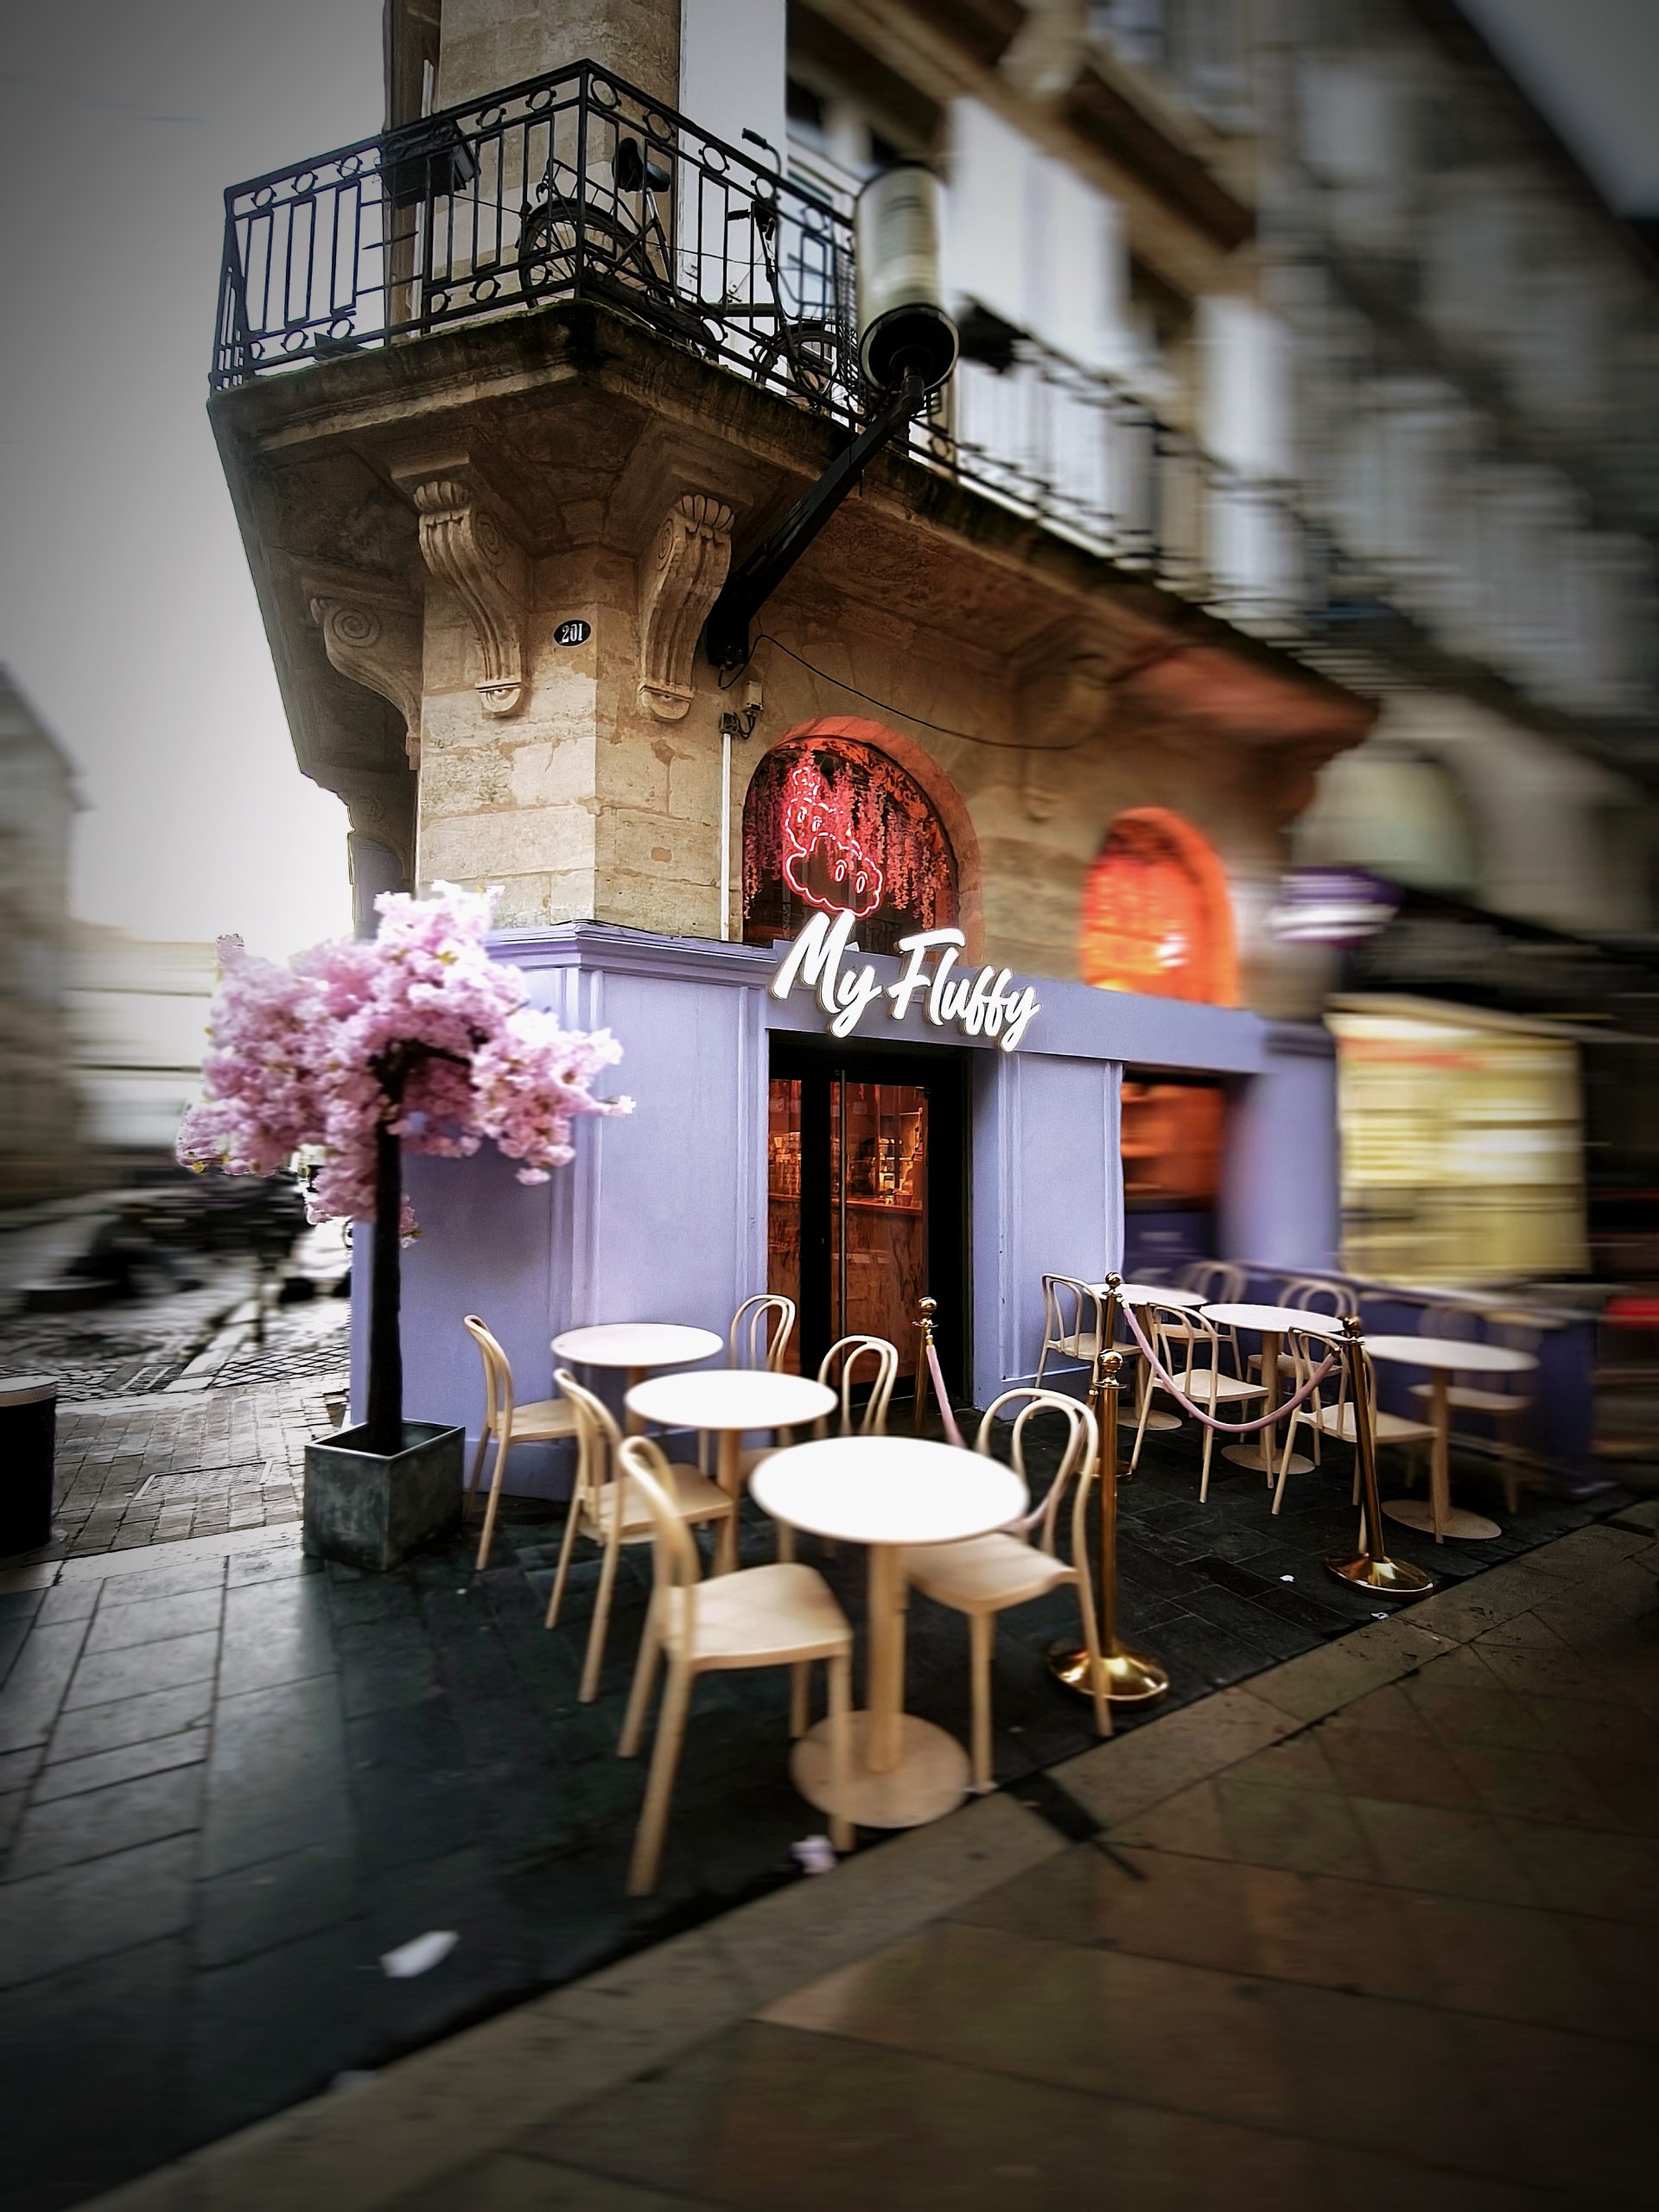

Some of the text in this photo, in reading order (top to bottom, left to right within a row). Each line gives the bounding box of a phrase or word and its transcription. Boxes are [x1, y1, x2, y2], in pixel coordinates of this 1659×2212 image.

[559, 623, 583, 644] 201
[772, 910, 1042, 1053] My Fluffy
